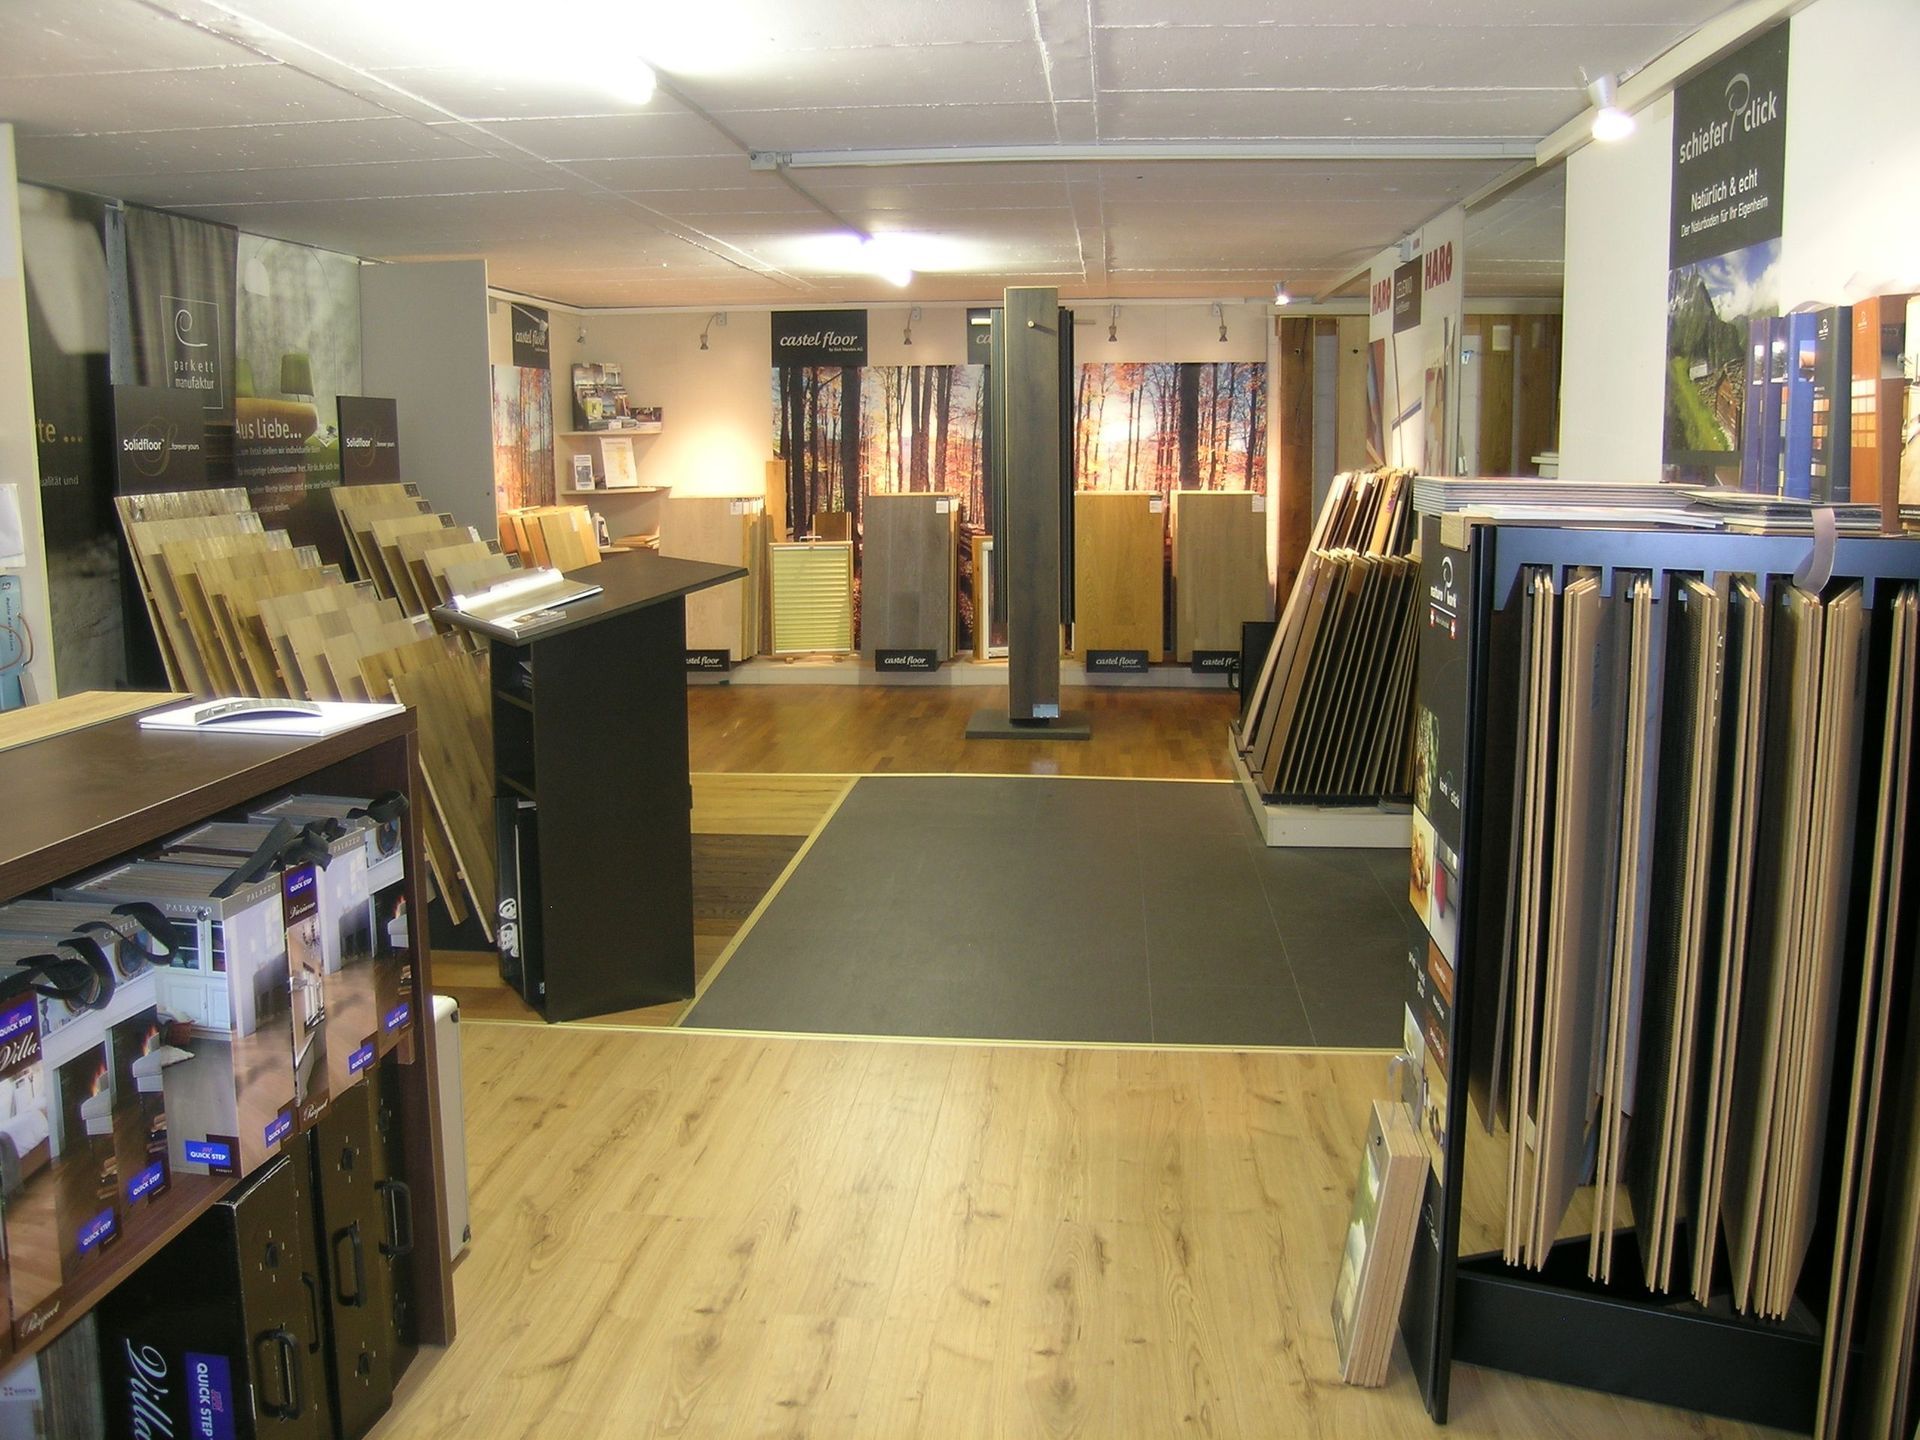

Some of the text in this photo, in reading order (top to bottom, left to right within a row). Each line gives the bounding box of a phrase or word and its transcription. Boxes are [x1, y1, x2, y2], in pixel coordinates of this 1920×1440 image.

[1679, 90, 1778, 164] schiefer click
[1691, 167, 1758, 213] Natürlich & echt
[1680, 194, 1768, 238] Der Naturboden für Ihr Eigenheim
[1424, 240, 1453, 291] HARO
[1372, 276, 1391, 316] HARO
[779, 331, 858, 349] castel floor
[173, 358, 215, 374] parkett
[174, 375, 215, 390] manufaktur
[37, 418, 57, 444] te
[235, 417, 302, 440] Aus Liebe...
[123, 438, 163, 452] Solidfloor
[346, 437, 372, 448] Solidfloor
[63, 474, 79, 486] und
[686, 655, 720, 666] stel floor
[884, 655, 927, 666] castel floor
[1095, 656, 1119, 666] castel
[1118, 656, 1138, 667] floor
[1201, 657, 1225, 667] castel
[246, 882, 277, 903] PALAZZO
[290, 877, 313, 893] QUICK STEP
[0, 1014, 33, 1038] QUICK STEP
[388, 1011, 408, 1029] QUICK STEP
[0, 1031, 38, 1073] Villa
[351, 1051, 373, 1069] QUICK STEP
[268, 1120, 290, 1142] QUICK STEP
[190, 1150, 227, 1161] QUICK STEP
[132, 1182, 149, 1196] QUICK
[149, 1173, 161, 1186] STEP
[82, 1229, 100, 1246] QUICK
[99, 1220, 112, 1234] STEP
[196, 1362, 214, 1437] QUICK STEP
